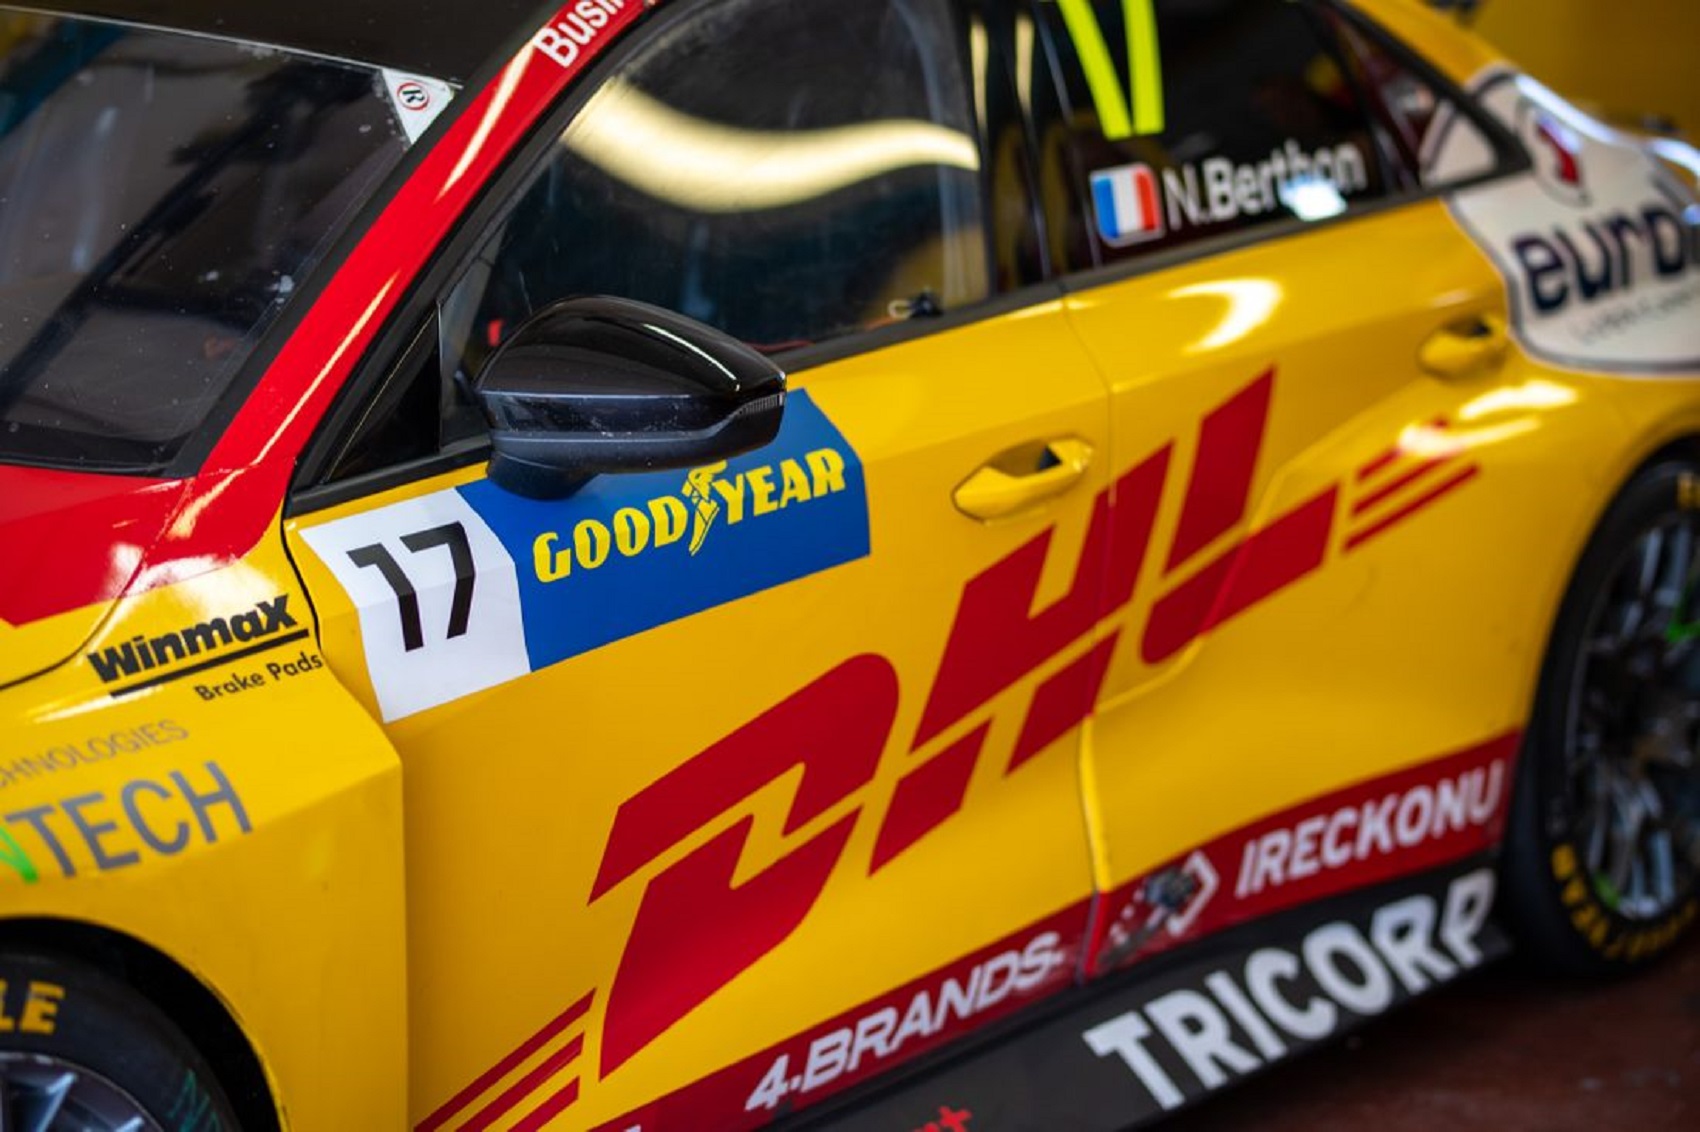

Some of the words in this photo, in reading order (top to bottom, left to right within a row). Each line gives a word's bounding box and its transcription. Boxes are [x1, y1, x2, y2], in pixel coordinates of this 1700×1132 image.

[533, 0, 625, 68] Busi
[532, 447, 846, 583] GOODYEAR
[346, 521, 476, 652] 17
[194, 672, 266, 702] Brake
[265, 651, 324, 682] Pads
[587, 364, 1339, 1081] DHL
[1236, 758, 1506, 899] IRECKONU
[1083, 868, 1497, 1112] TRICORP
